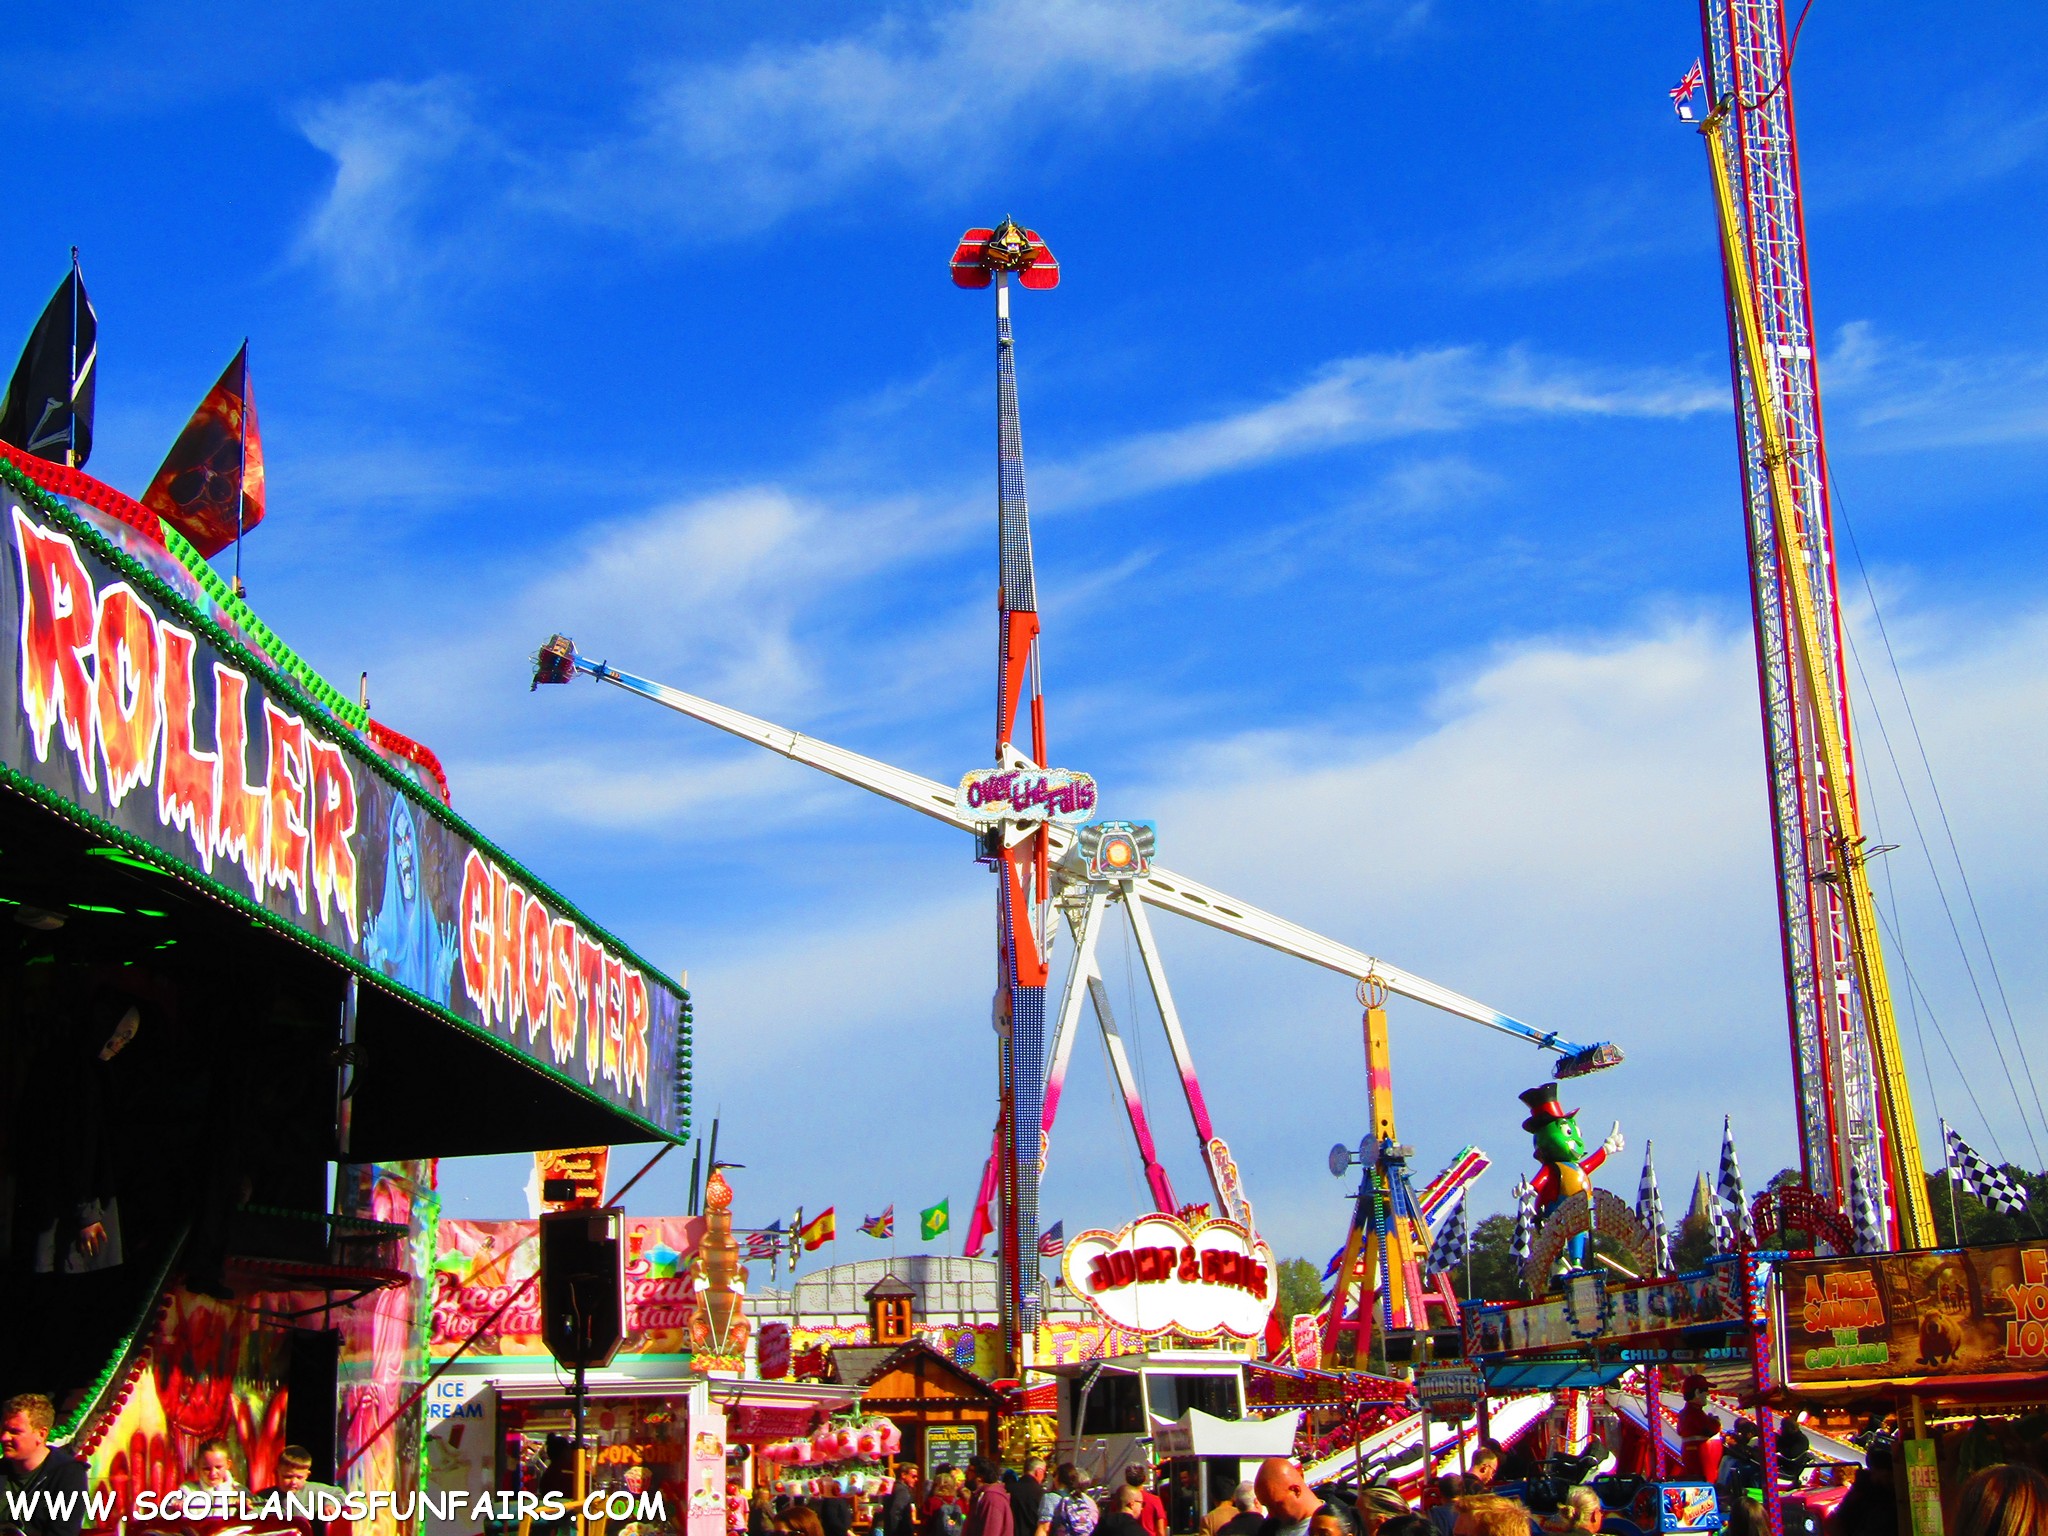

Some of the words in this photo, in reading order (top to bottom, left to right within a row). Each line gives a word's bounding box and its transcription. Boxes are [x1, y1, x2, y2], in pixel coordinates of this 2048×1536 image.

[12, 505, 359, 943] ROLLER
[459, 848, 650, 1107] GHOSTER
[968, 772, 1020, 808] Over
[1042, 780, 1095, 817] Falls
[1086, 1246, 1178, 1294] JUMP
[1177, 1244, 1200, 1284] &
[1805, 1275, 1825, 1304] A
[1824, 1270, 1879, 1302] FREE
[2006, 1283, 2048, 1322] YO
[1803, 1297, 1886, 1334] SAMBA
[1832, 1328, 1859, 1347] THE
[2006, 1320, 2048, 1358] LO
[1620, 1350, 1668, 1361] CHILD
[1805, 1343, 1890, 1370] CAPYBARA
[437, 1382, 464, 1397] ICE
[1420, 1374, 1479, 1398] MONSTER
[427, 1403, 483, 1418] REAM
